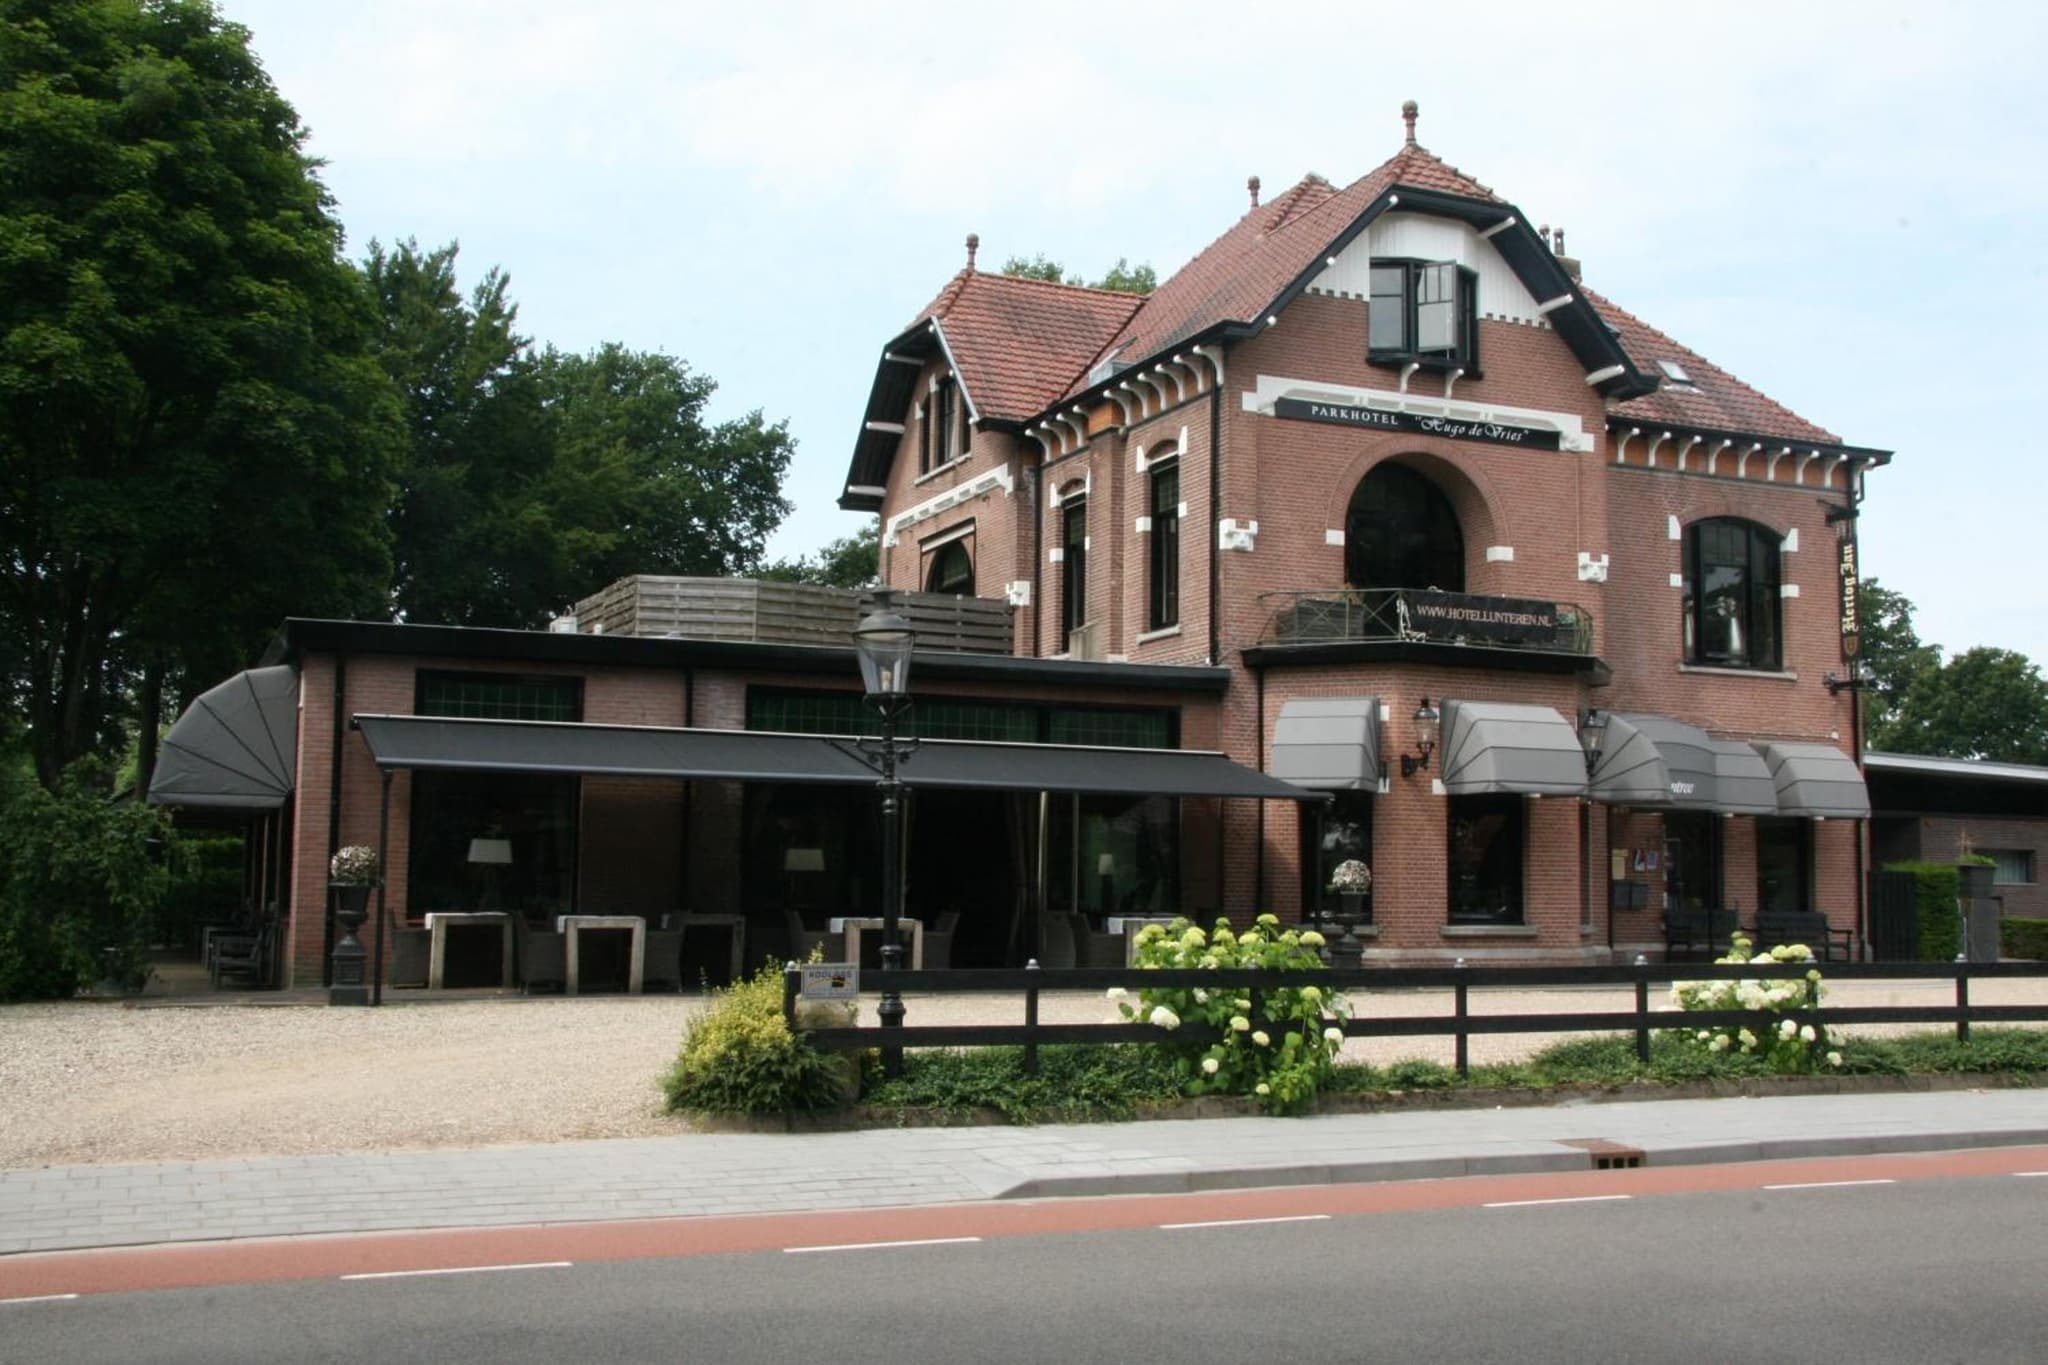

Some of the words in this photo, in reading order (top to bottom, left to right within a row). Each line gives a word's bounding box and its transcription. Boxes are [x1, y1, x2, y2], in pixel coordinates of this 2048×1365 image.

[1311, 405, 1399, 426] PARKHOTEL
[1468, 423, 1483, 437] de
[1841, 544, 1856, 575] Jan
[1416, 604, 1551, 627] WWW.HOTELLUNTEREN.NL
[1842, 577, 1858, 633] Hertog
